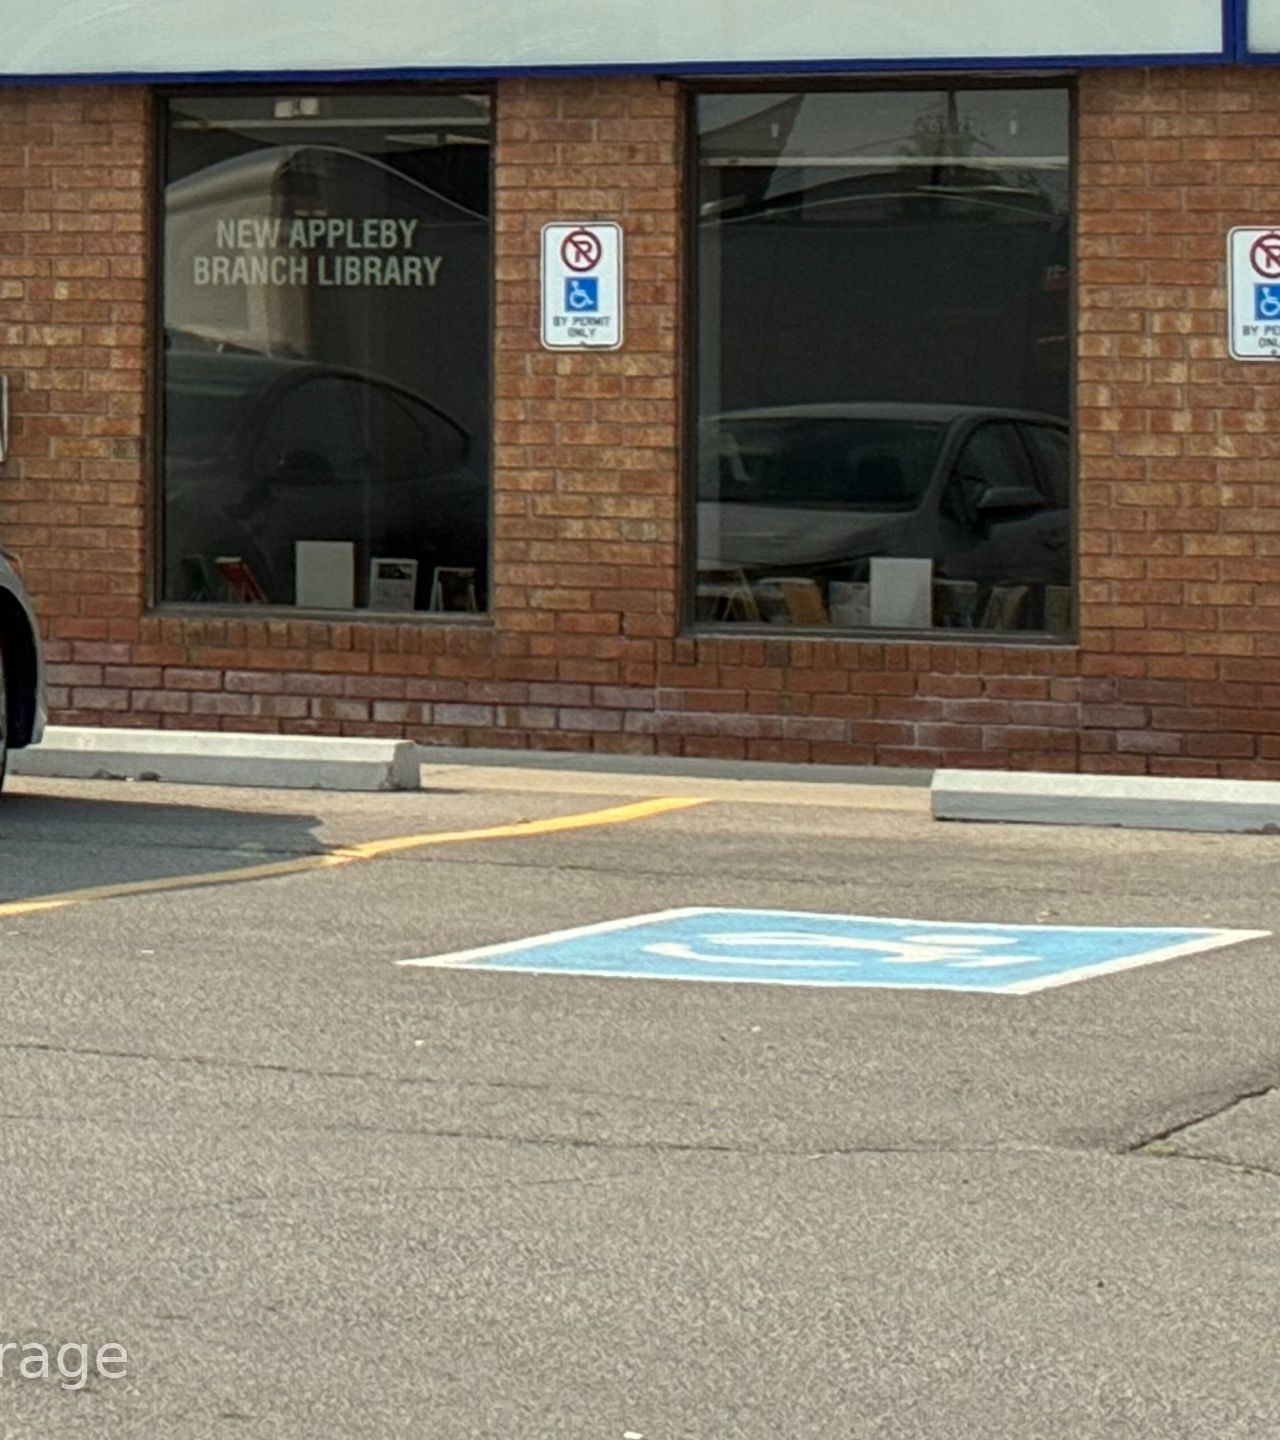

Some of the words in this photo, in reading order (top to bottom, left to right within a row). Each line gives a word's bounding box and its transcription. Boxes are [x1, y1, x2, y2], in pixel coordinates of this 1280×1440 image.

[216, 218, 281, 248] NEW
[289, 218, 419, 248] APPLEBY
[193, 255, 308, 286] BRANCH
[317, 255, 442, 286] LIBRARY
